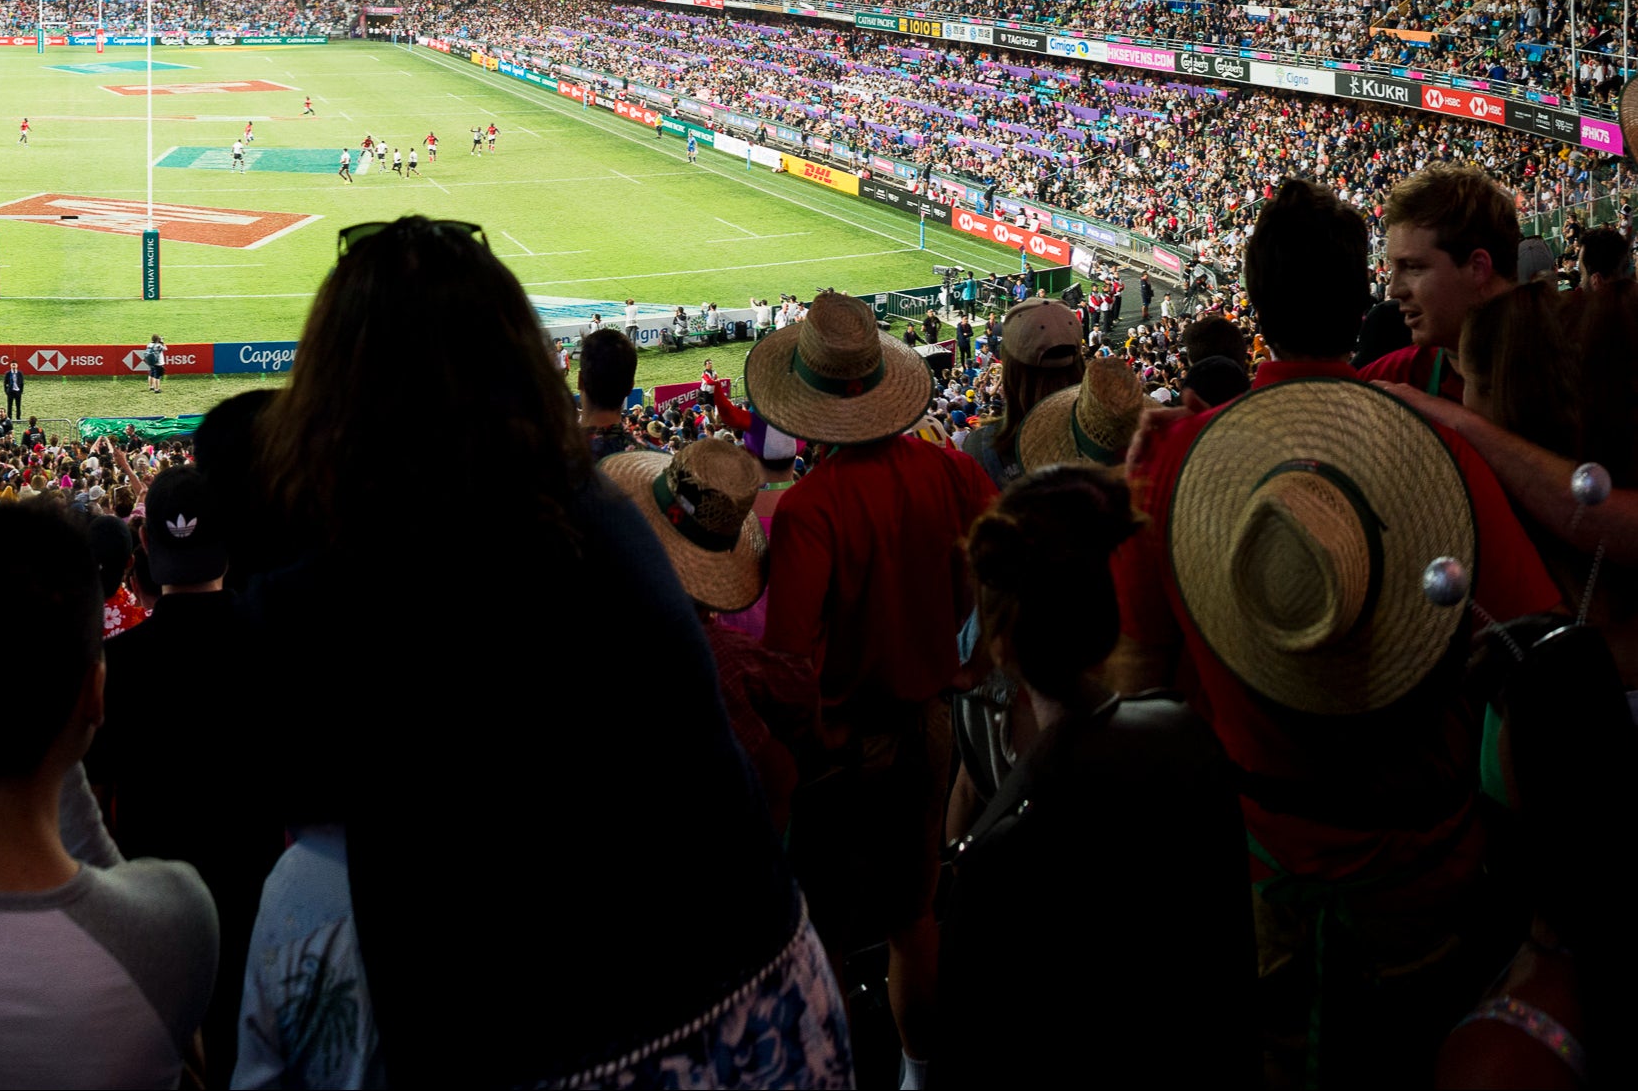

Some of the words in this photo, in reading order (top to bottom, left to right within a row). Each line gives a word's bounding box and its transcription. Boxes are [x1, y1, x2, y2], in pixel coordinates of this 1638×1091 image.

[857, 17, 876, 26] CATHAY
[877, 19, 896, 28] PACIFIC
[910, 21, 930, 34] 1010
[1050, 38, 1076, 56] Cimigo
[1107, 47, 1175, 69] HKSEVENS.COM
[1180, 53, 1209, 72] Carlsberg
[1214, 57, 1244, 76] Carlsberg
[1286, 72, 1309, 87] Cigna
[1362, 79, 1408, 102] KUKRI
[1444, 96, 1461, 108] HSBC
[1488, 105, 1503, 117] HSBC
[1581, 125, 1610, 144] #HK7S
[804, 163, 833, 185] DHL
[1046, 244, 1062, 256] HSBC
[899, 295, 943, 310] CATHA
[70, 355, 104, 366] HSBC
[166, 354, 196, 365] HSBC
